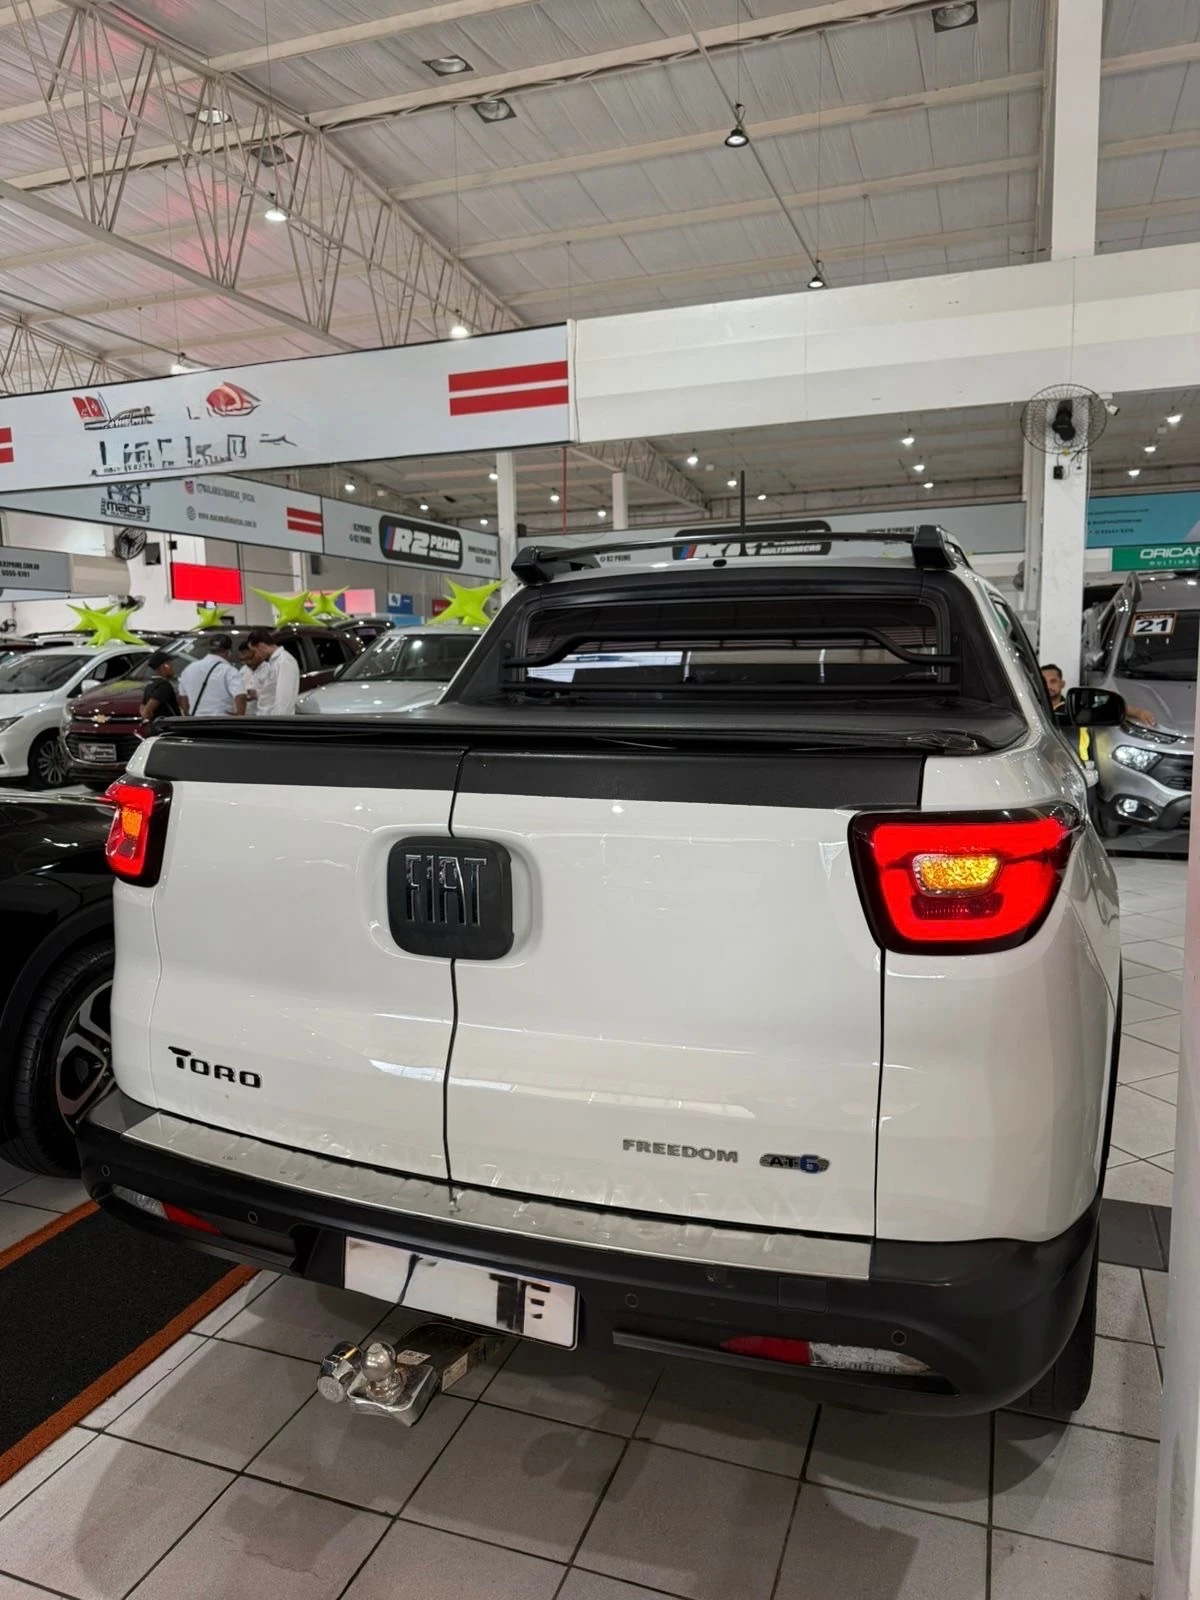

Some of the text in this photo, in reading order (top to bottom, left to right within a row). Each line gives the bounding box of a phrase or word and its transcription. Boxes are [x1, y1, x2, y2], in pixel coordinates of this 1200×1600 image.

[107, 501, 146, 516] maca
[392, 527, 430, 556] R2
[430, 534, 461, 553] PRIME
[760, 544, 822, 555] MULTIMARCAS
[1136, 619, 1169, 633] 21
[405, 854, 487, 926] FIAT
[168, 1046, 262, 1089] TORO
[622, 1138, 739, 1164] FREEDOM
